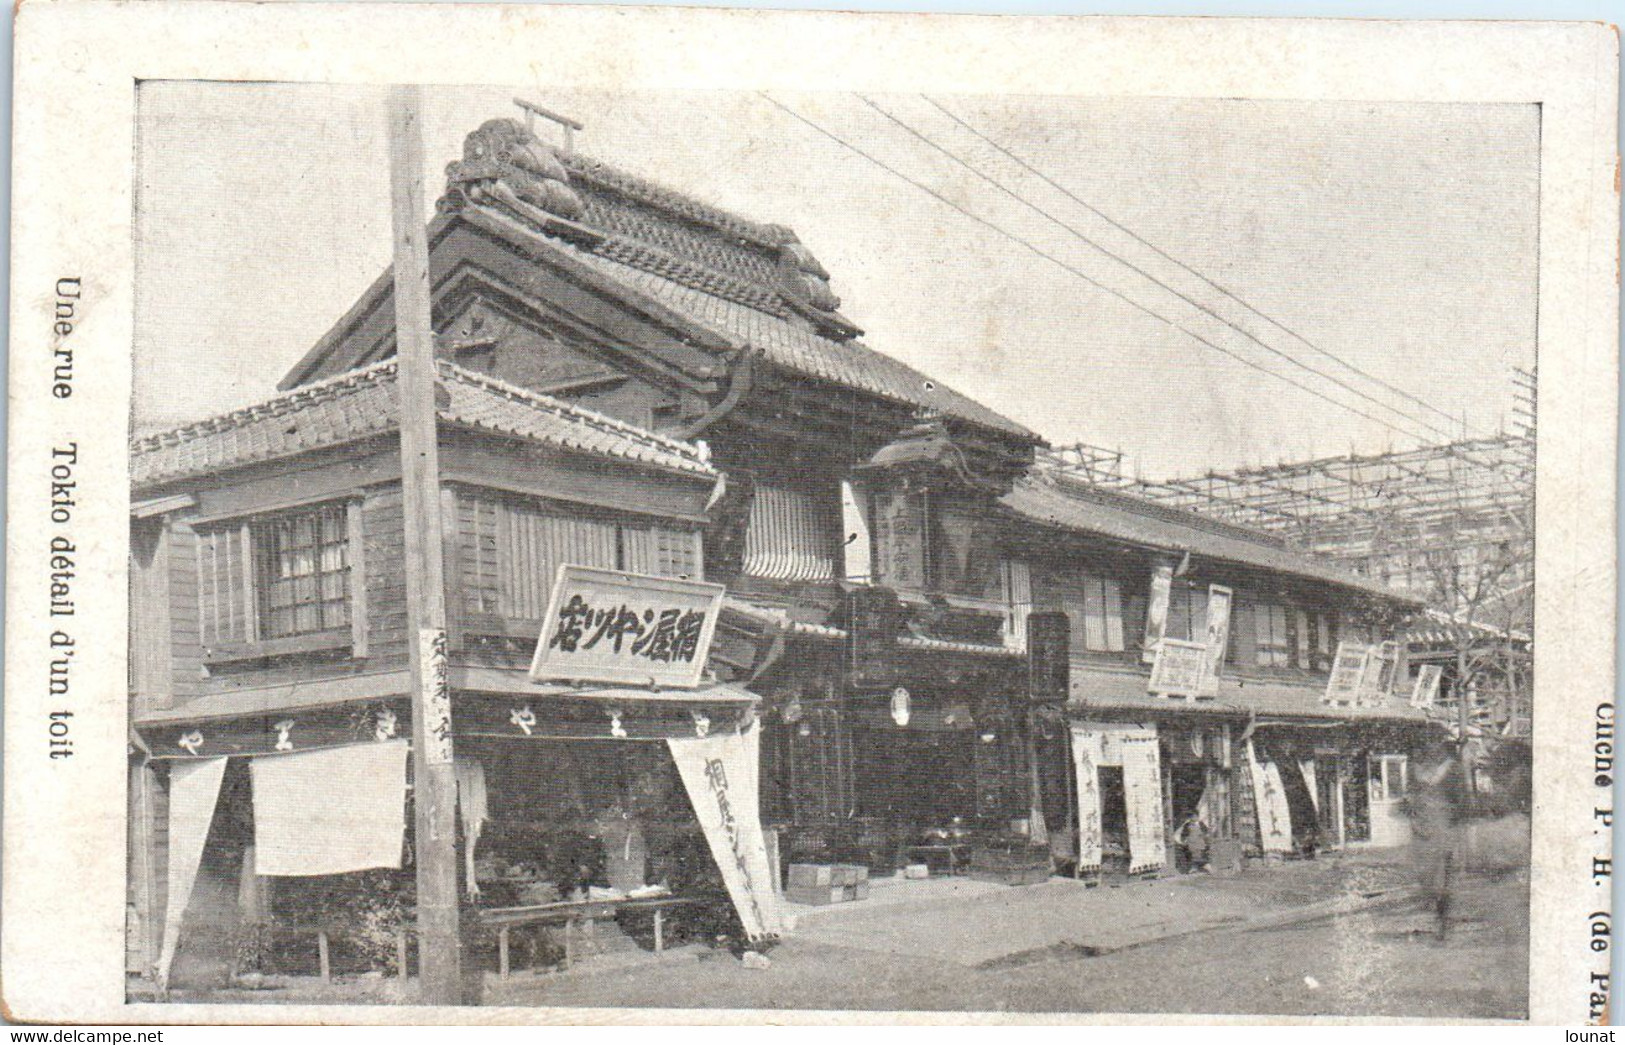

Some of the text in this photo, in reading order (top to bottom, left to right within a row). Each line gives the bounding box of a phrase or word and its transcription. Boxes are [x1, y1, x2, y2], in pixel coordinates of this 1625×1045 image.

[48, 276, 81, 760] Une rue Tokio détail d'un toit
[1593, 806, 1613, 835] P.
[1592, 856, 1612, 887] H.
[1588, 911, 1612, 952] (de
